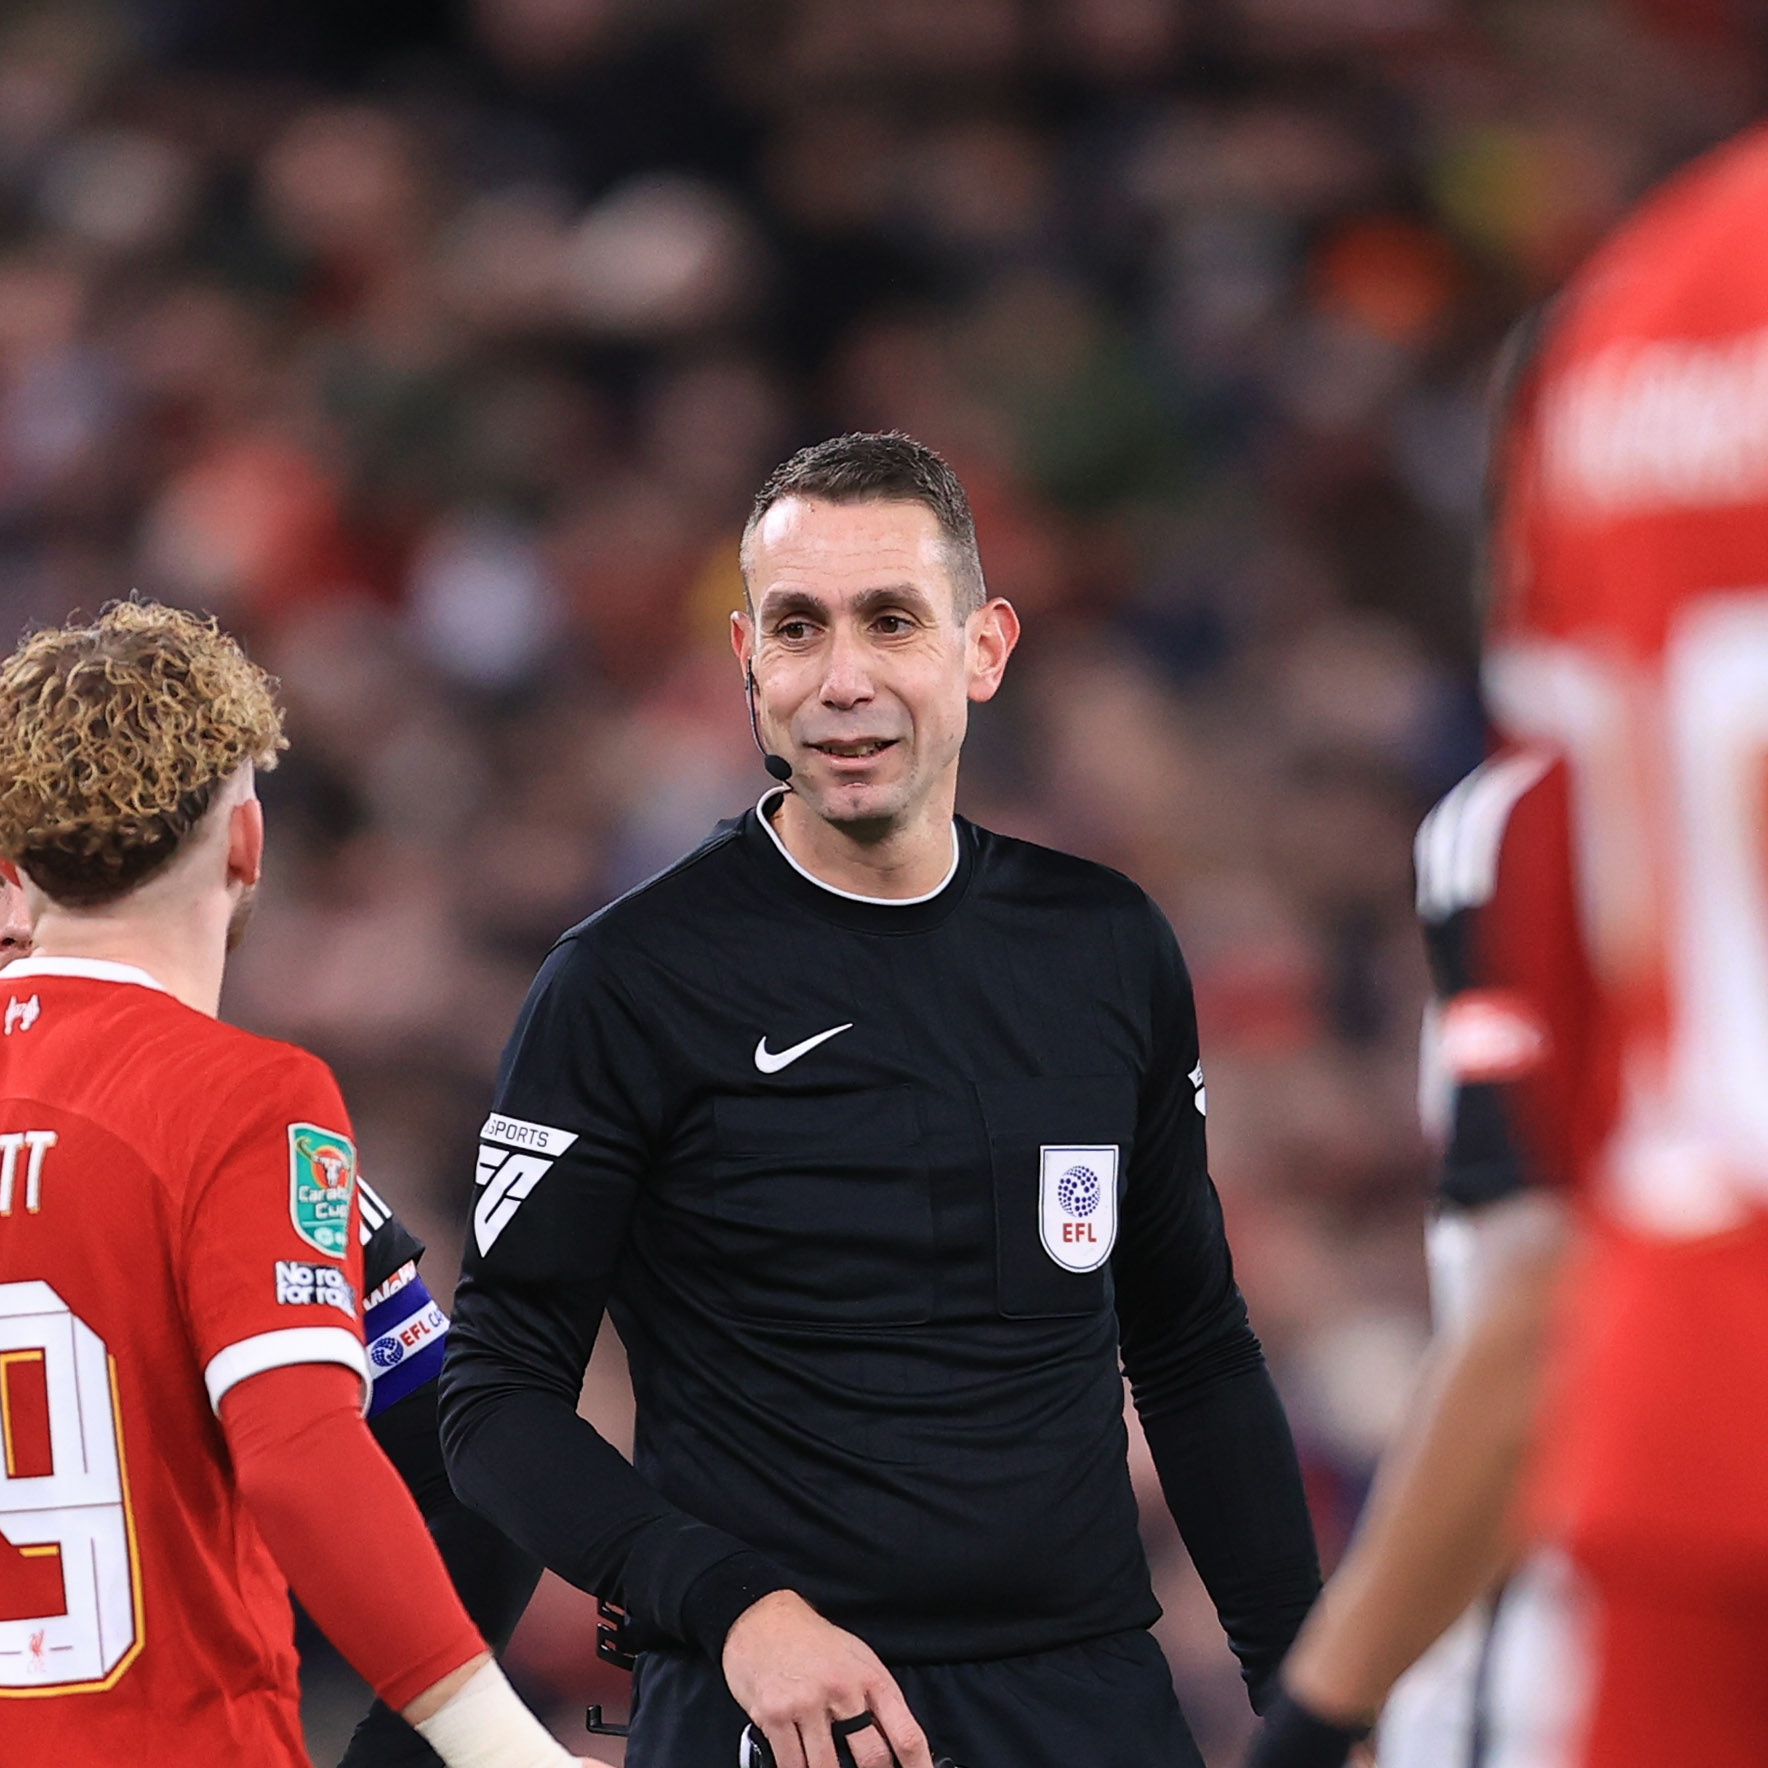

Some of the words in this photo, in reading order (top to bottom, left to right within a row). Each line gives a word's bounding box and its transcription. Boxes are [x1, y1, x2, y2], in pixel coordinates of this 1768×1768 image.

[1063, 1222, 1098, 1243] EFL
[275, 1261, 314, 1286] No
[399, 1320, 431, 1347] EFL
